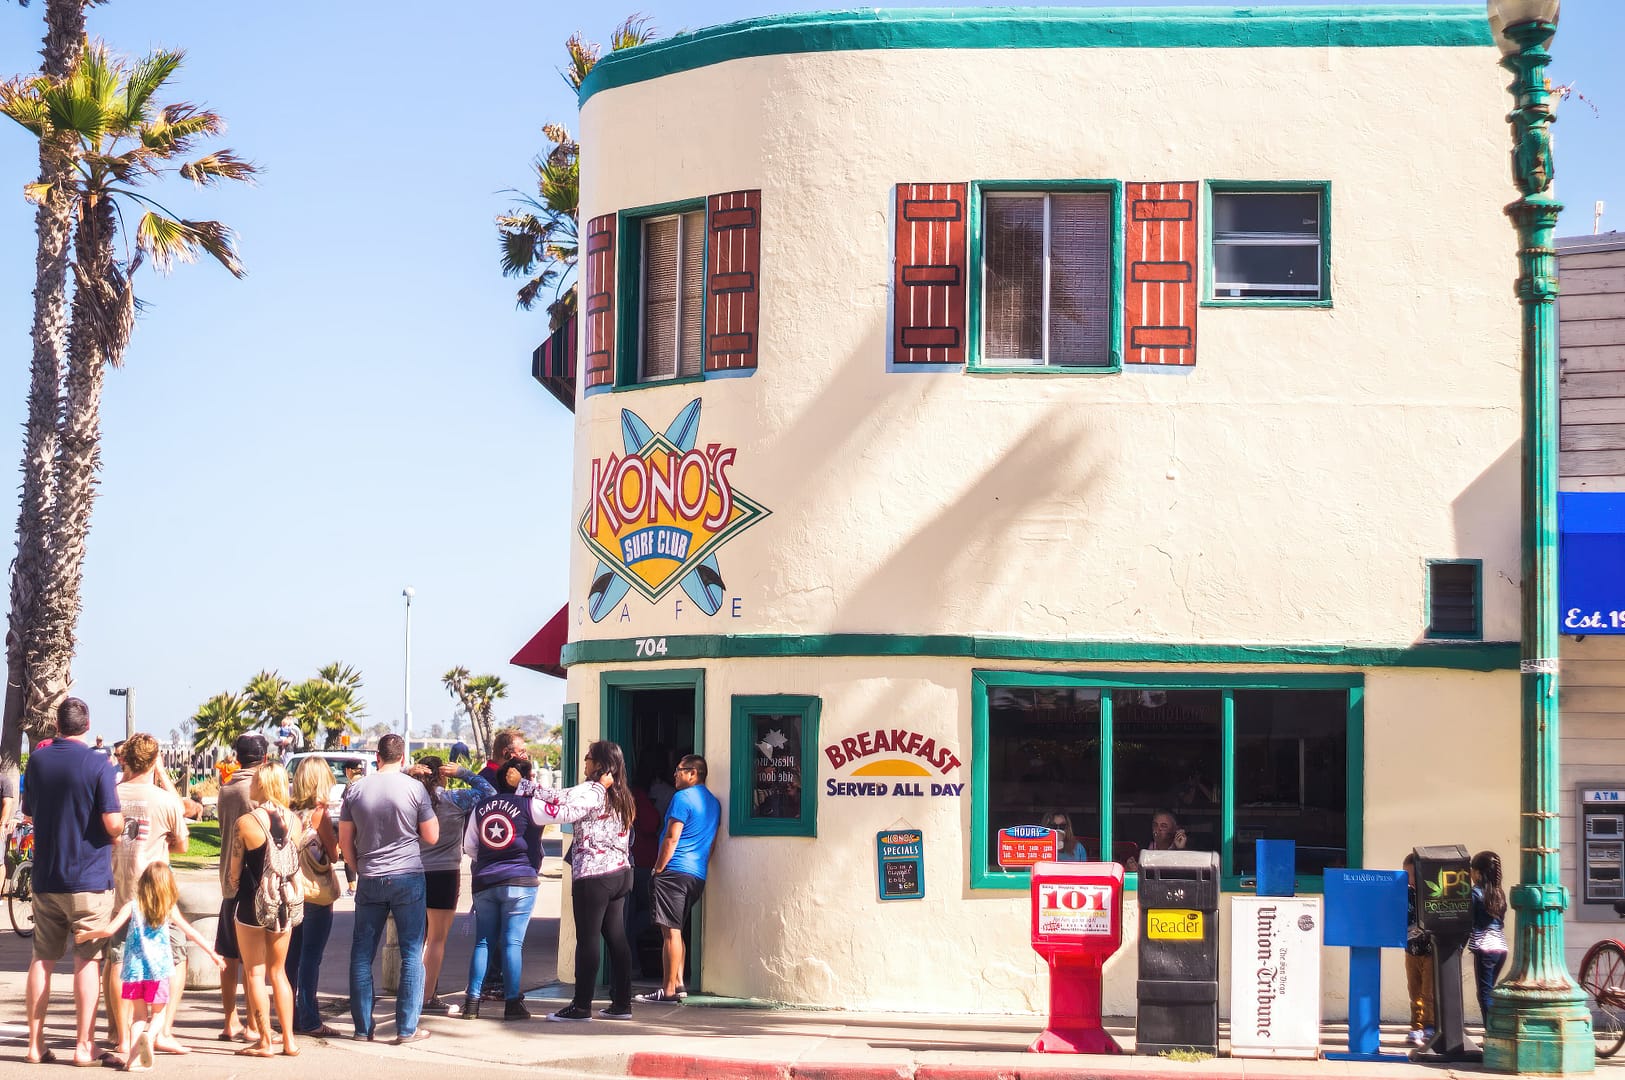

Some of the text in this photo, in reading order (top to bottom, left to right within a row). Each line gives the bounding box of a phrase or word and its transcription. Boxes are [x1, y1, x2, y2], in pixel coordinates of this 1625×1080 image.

[590, 443, 737, 538] KONO'S
[625, 529, 688, 562] SURF CLUB
[1565, 607, 1608, 628] Est.
[636, 638, 667, 657] 704
[824, 729, 962, 775] BREAKFAST
[826, 778, 965, 797] SERVED ALL DAY
[1594, 791, 1619, 800] ATM
[479, 800, 521, 818] CAPTAIN
[1014, 827, 1040, 837] HOURS
[883, 845, 919, 856] SPECIALS
[1041, 890, 1108, 911] 101
[1424, 900, 1470, 911] PotSaver
[1150, 917, 1200, 933] Reader
[1257, 905, 1278, 1038] Union-Tribune
